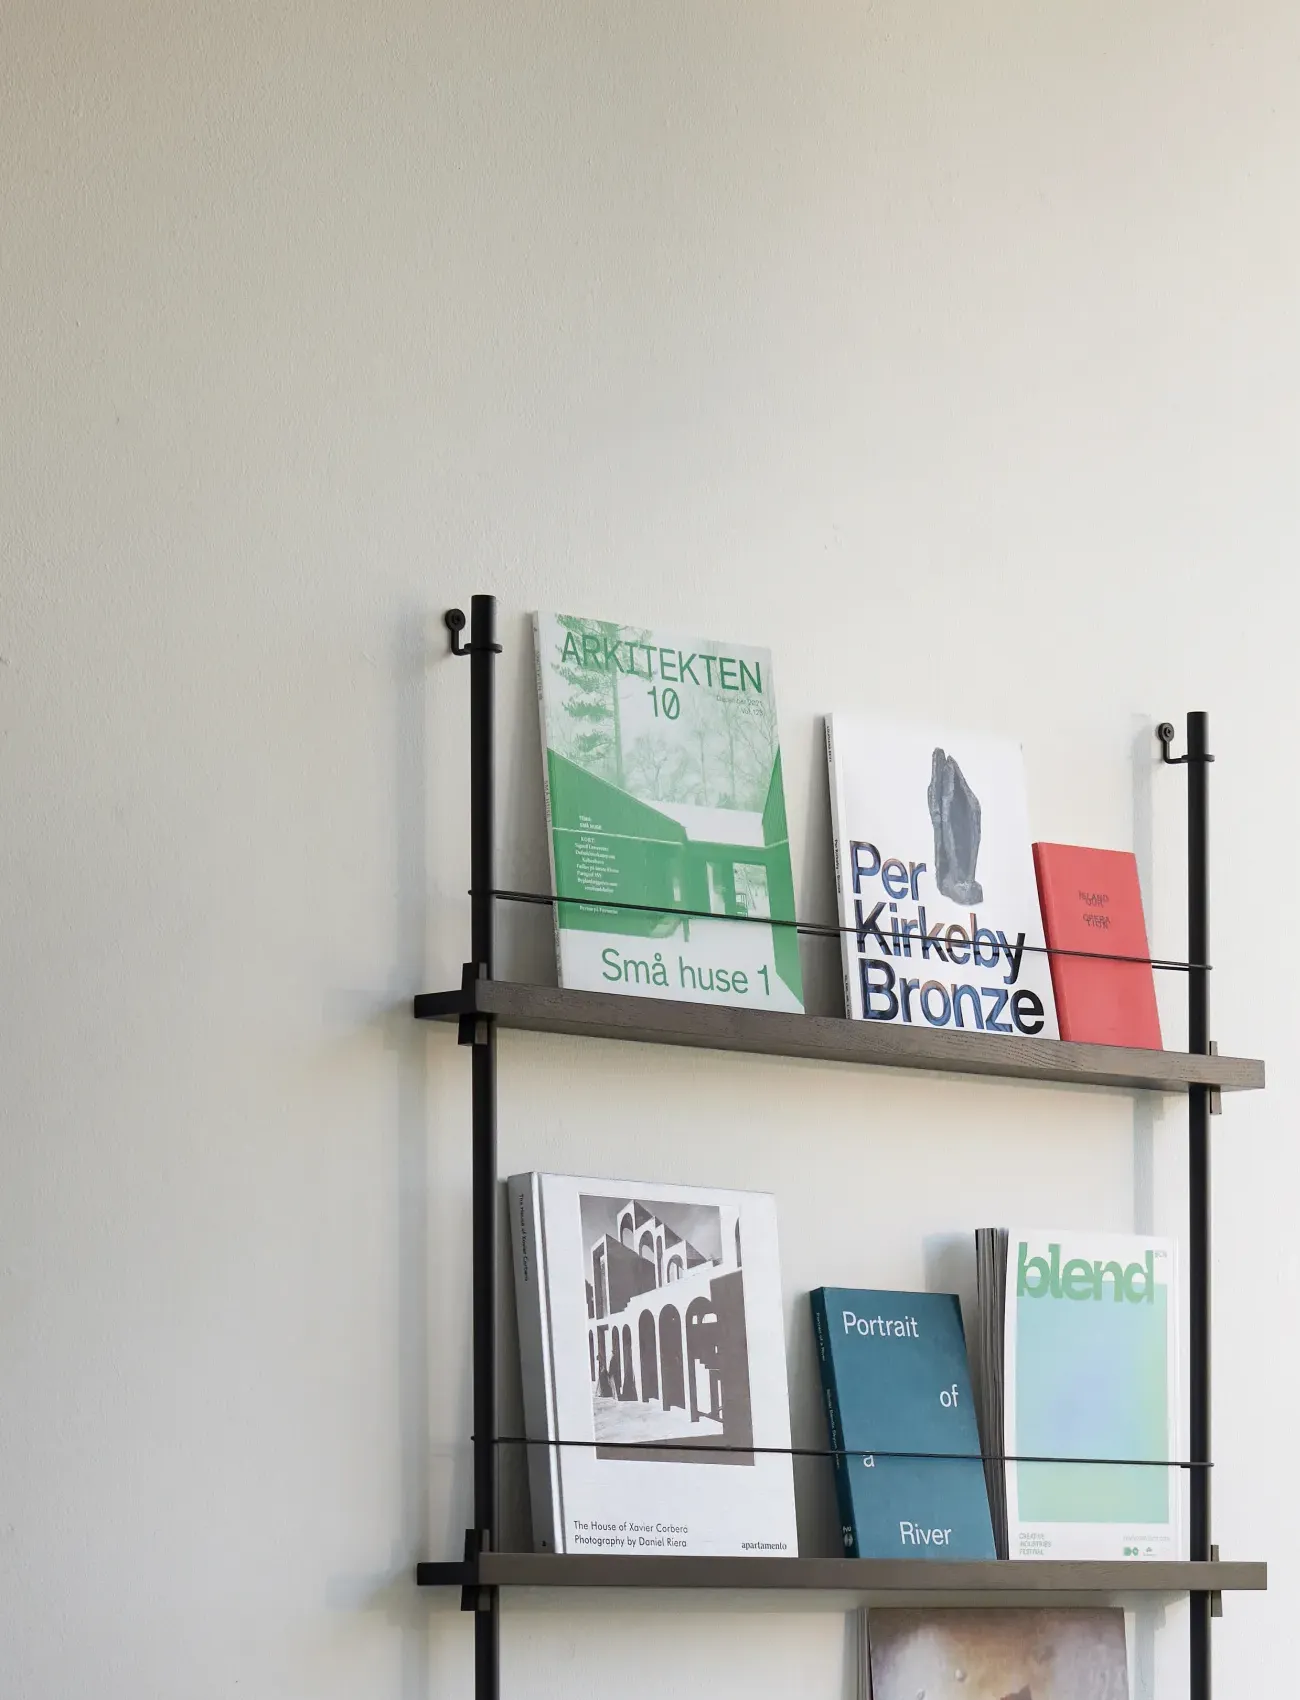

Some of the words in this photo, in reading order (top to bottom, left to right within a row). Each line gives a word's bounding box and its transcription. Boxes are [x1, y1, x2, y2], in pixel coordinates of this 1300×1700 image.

[561, 631, 763, 694] ARKITEKTEN
[647, 686, 681, 720] 10
[849, 840, 927, 901] Per
[853, 899, 1025, 985] Kirkeby
[601, 947, 669, 986] Små
[678, 956, 748, 994] huse
[757, 965, 770, 996] 1
[858, 958, 1045, 1035] Bronze
[1016, 1241, 1154, 1305] blend
[842, 1310, 920, 1338] Portrait
[939, 1383, 959, 1407] of
[574, 1520, 589, 1530] The
[590, 1521, 617, 1532] House
[618, 1522, 627, 1532] of
[629, 1522, 654, 1533] Xavier
[574, 1534, 625, 1547] Photography
[627, 1535, 637, 1547] by
[638, 1536, 665, 1547] Daniel
[667, 1537, 687, 1548] Riera
[899, 1521, 952, 1546] River
[741, 1541, 788, 1550] apartamento
